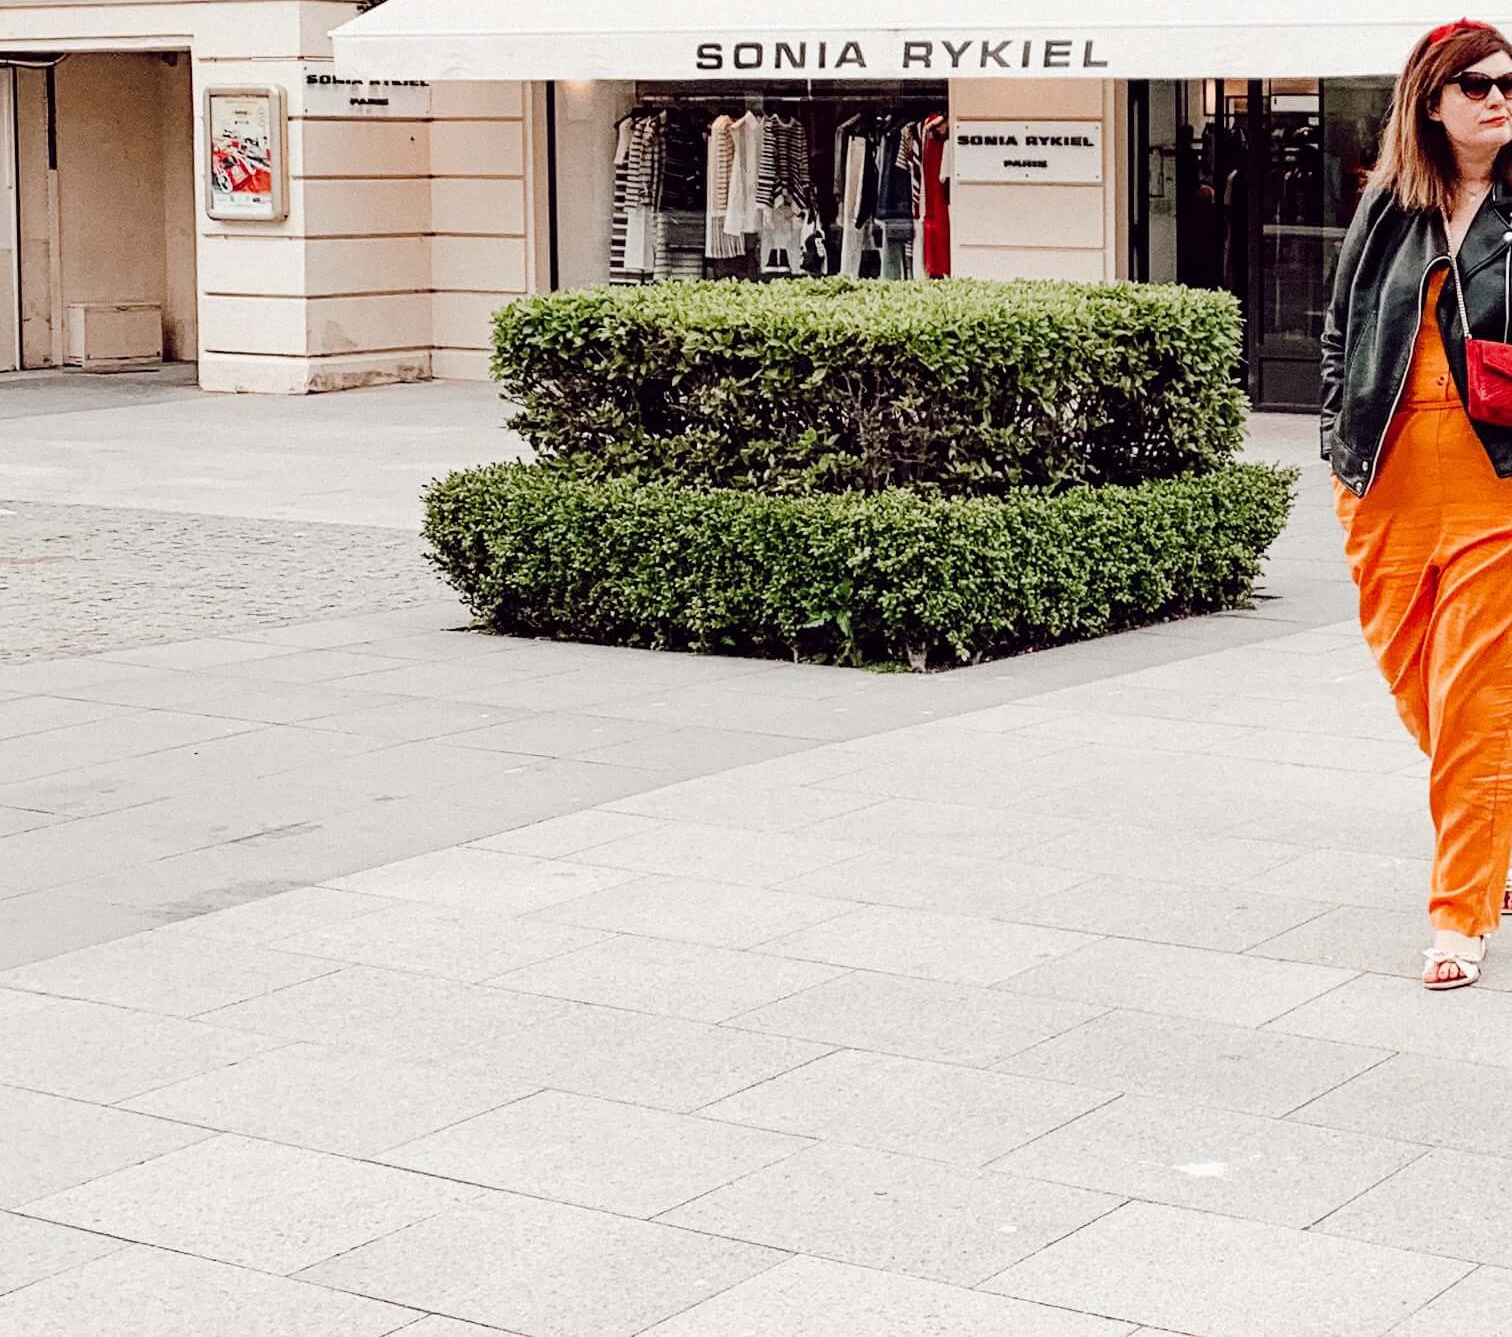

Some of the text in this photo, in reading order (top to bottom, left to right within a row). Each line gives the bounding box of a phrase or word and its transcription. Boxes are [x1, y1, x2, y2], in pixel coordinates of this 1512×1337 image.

[696, 39, 1109, 70] SONIA RYKIEL
[957, 135, 1095, 148] SONIA RYKIEL
